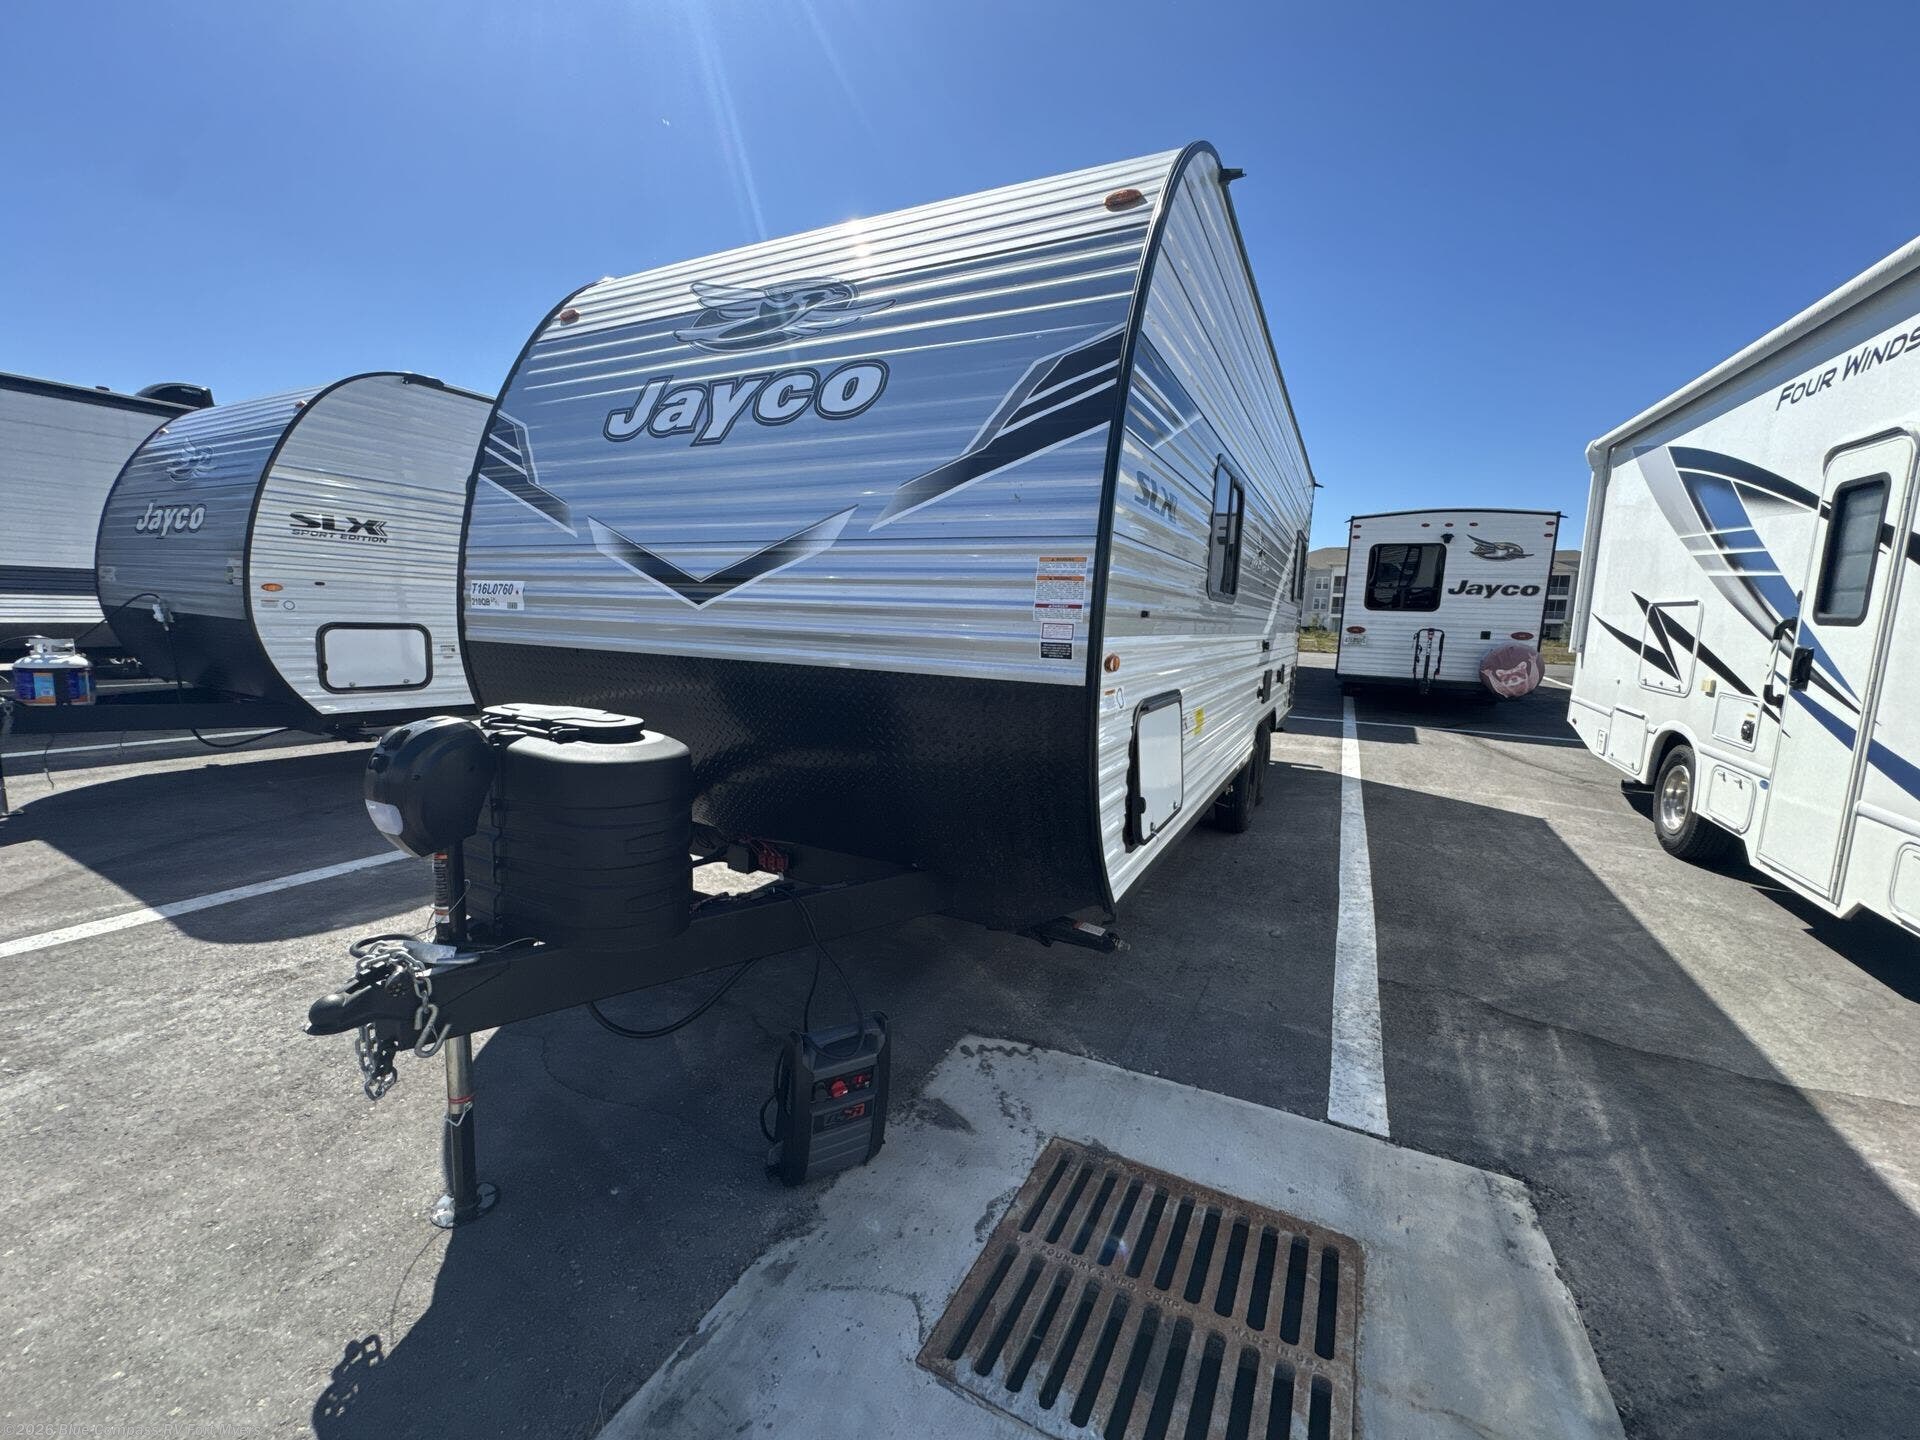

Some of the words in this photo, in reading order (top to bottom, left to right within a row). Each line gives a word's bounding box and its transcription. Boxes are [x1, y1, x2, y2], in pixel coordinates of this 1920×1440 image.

[1775, 366, 1838, 411] FOUR
[1842, 325, 1920, 382] WINDS
[603, 359, 890, 447] Jayco
[1134, 470, 1178, 524] SLX
[134, 501, 208, 538] Jayco
[289, 511, 388, 537] SLX
[291, 528, 336, 540] SPORT
[339, 532, 388, 543] EDITION
[472, 583, 514, 595] T16L0760
[1447, 580, 1541, 599] Jayco
[1040, 1245, 1096, 1274] FOUNDRY
